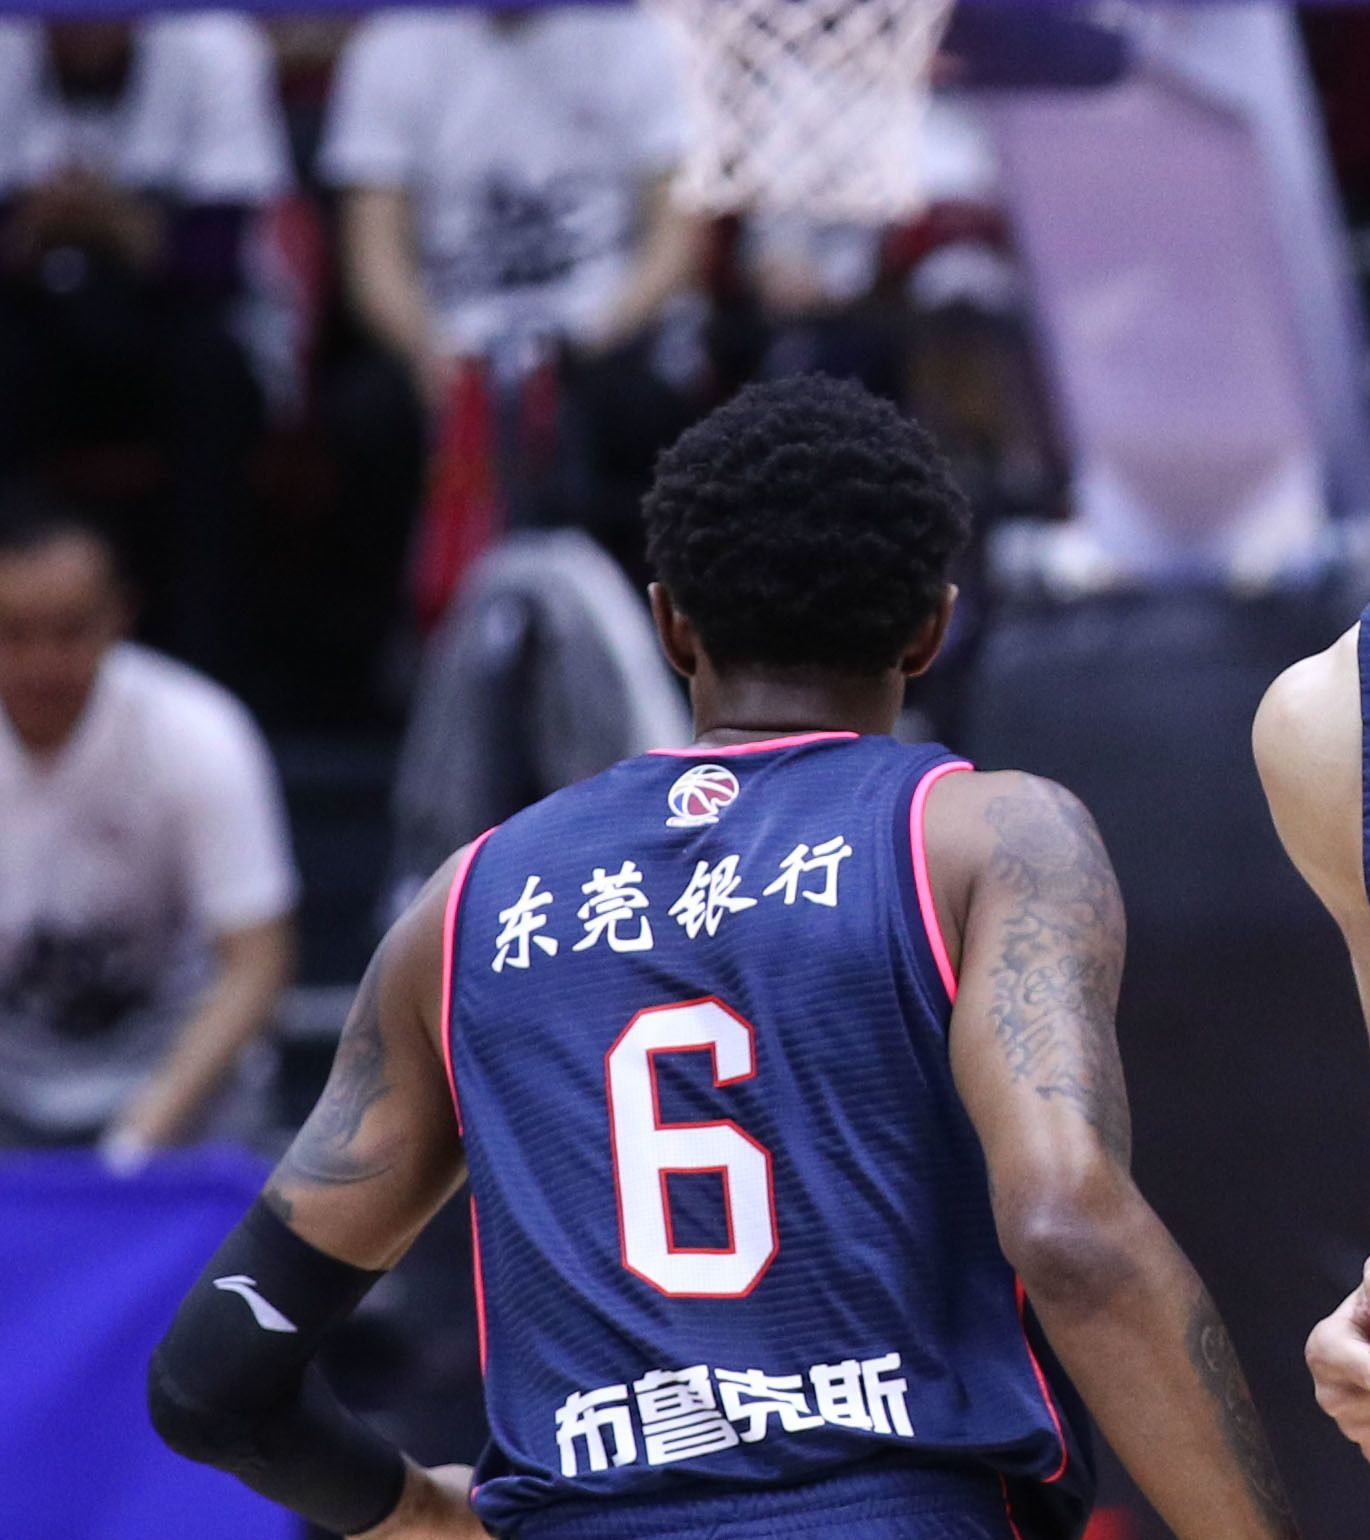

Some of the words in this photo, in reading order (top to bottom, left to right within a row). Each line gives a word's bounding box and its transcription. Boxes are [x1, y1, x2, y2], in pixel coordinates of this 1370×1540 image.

[491, 836, 853, 973] 东莞银行
[604, 995, 779, 1299] 6
[555, 1352, 916, 1478] 布鲁克斯
